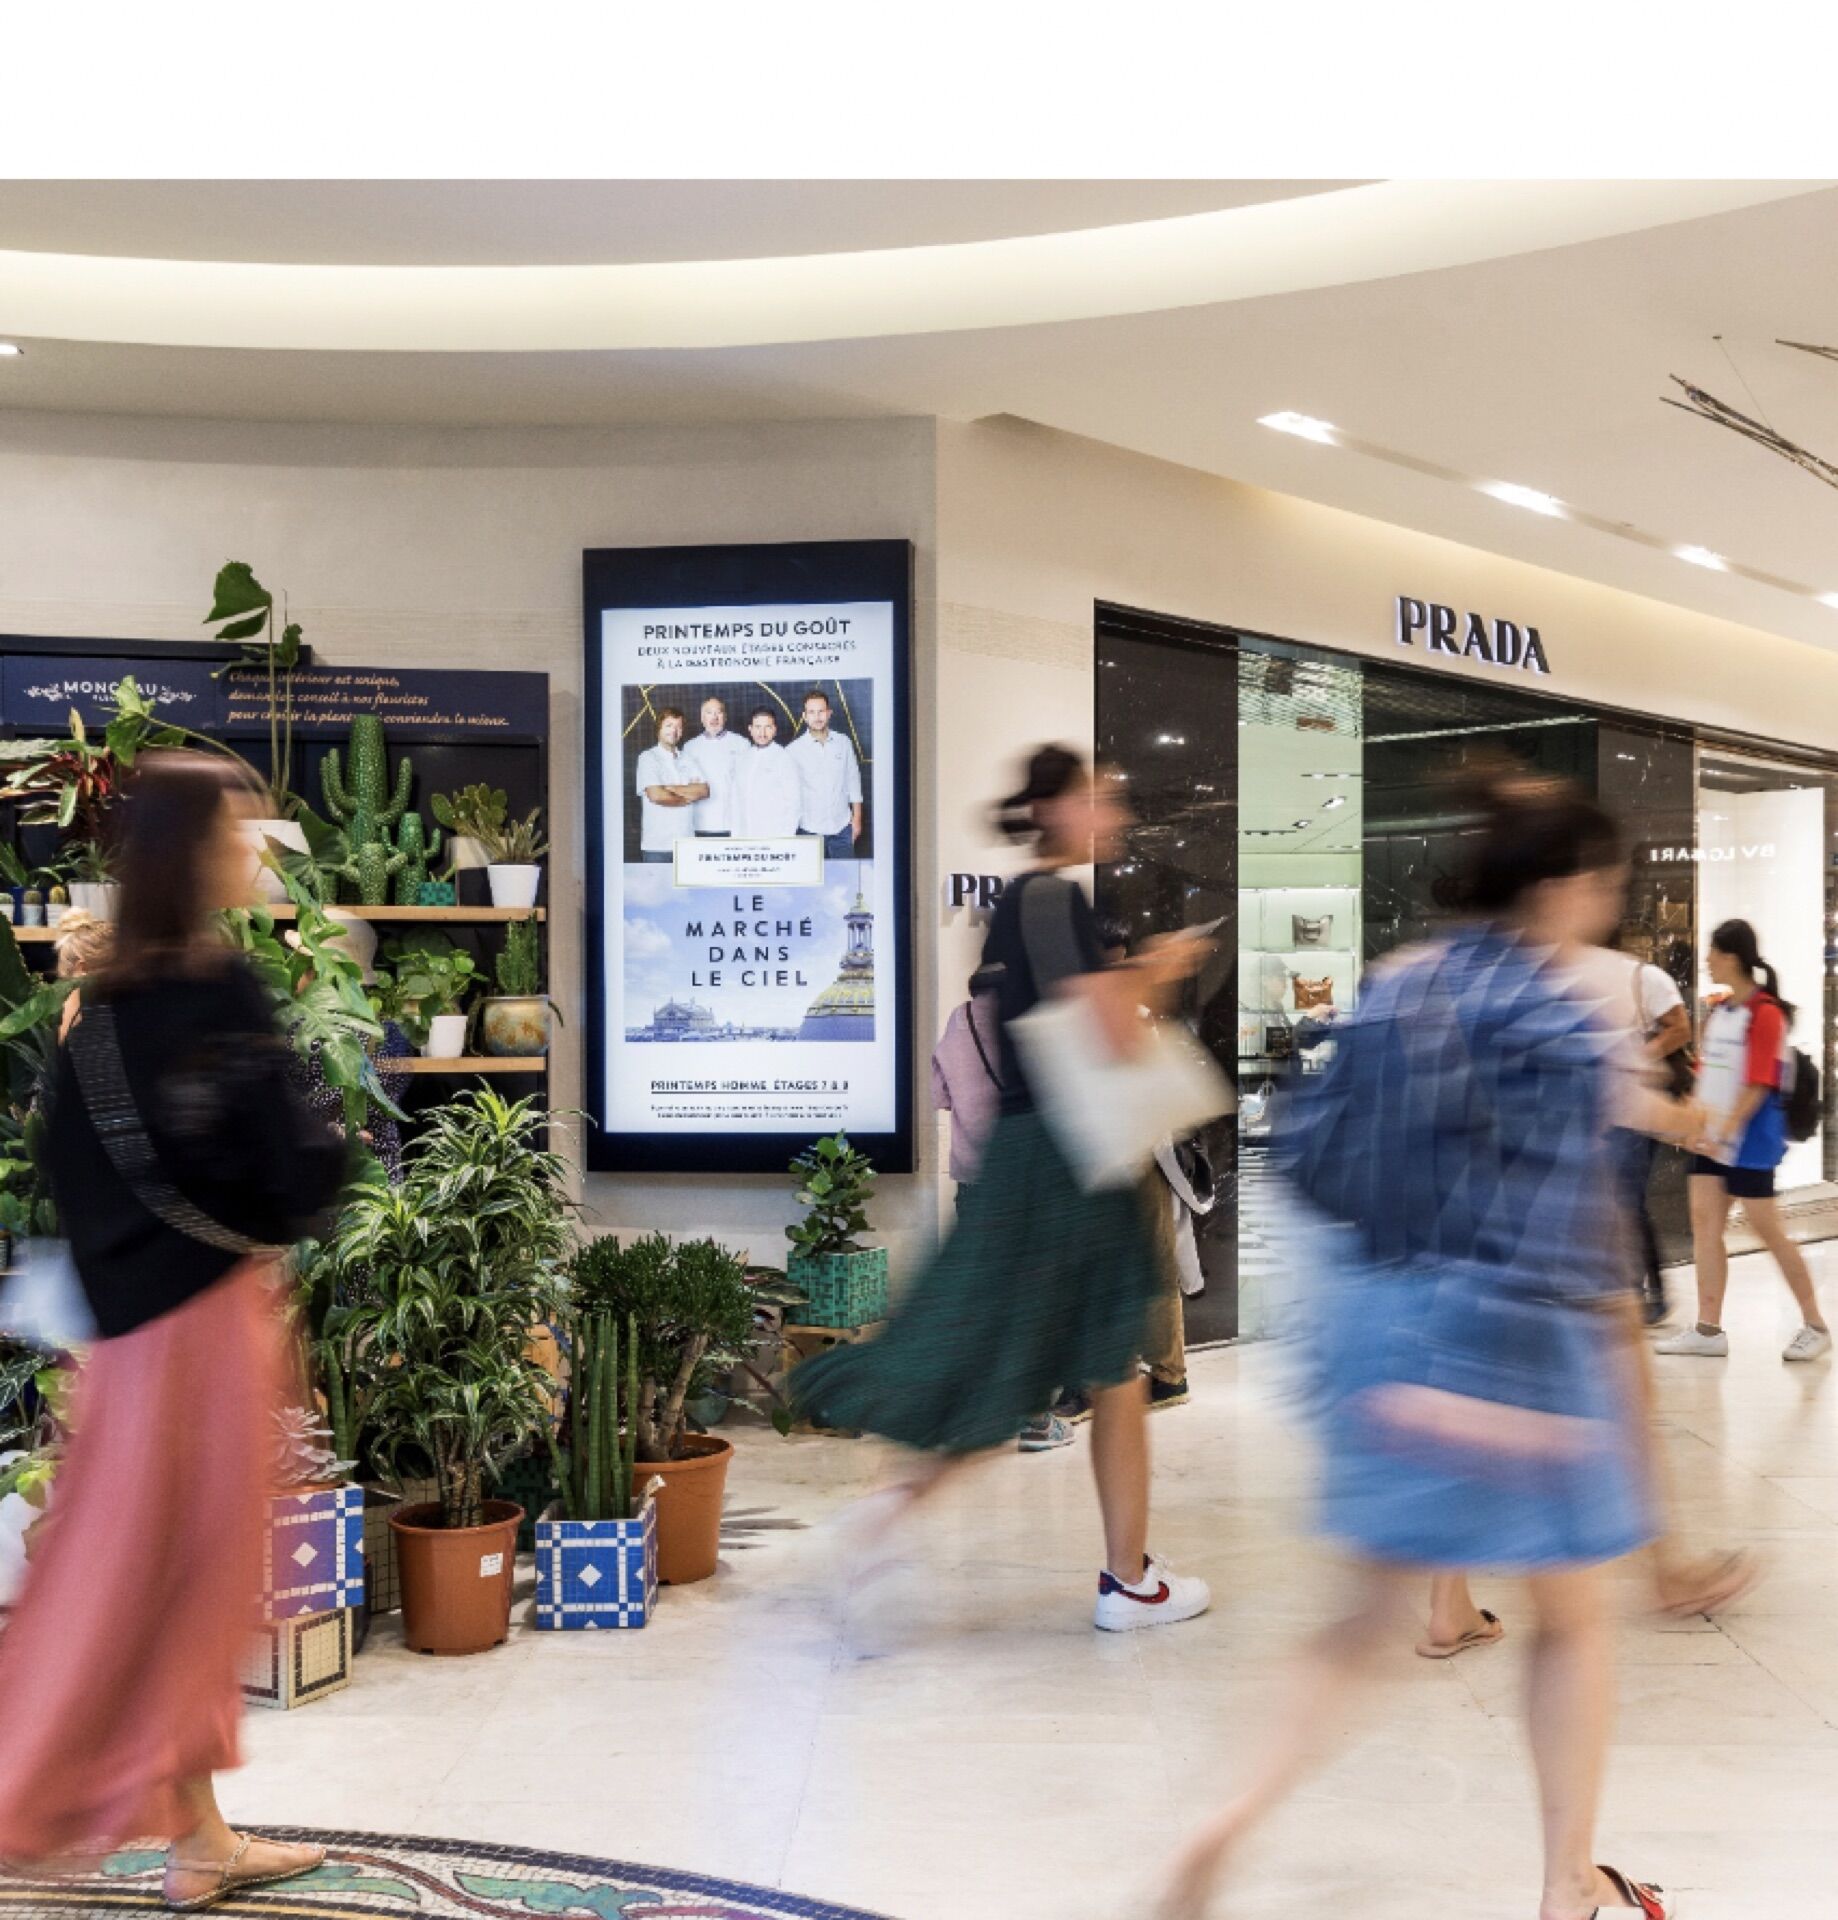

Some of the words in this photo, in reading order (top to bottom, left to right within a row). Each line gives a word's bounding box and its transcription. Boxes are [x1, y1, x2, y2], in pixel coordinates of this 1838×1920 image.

[643, 623, 754, 640] PRINTEMPS
[760, 621, 788, 637] DU
[793, 616, 851, 635] GOÛT
[1396, 595, 1551, 674] PRADA
[669, 659, 683, 668] LA
[64, 681, 158, 695] MONCAU
[317, 709, 357, 726] plant
[734, 895, 764, 912] LE
[686, 916, 813, 937] MARCHÉ
[709, 945, 790, 962] DANS
[691, 970, 722, 987] LE
[741, 970, 808, 987] CIEL
[651, 1080, 717, 1091] PRINTEMPS
[721, 1080, 767, 1090] HOMME
[774, 1078, 818, 1090] ÉTAGES
